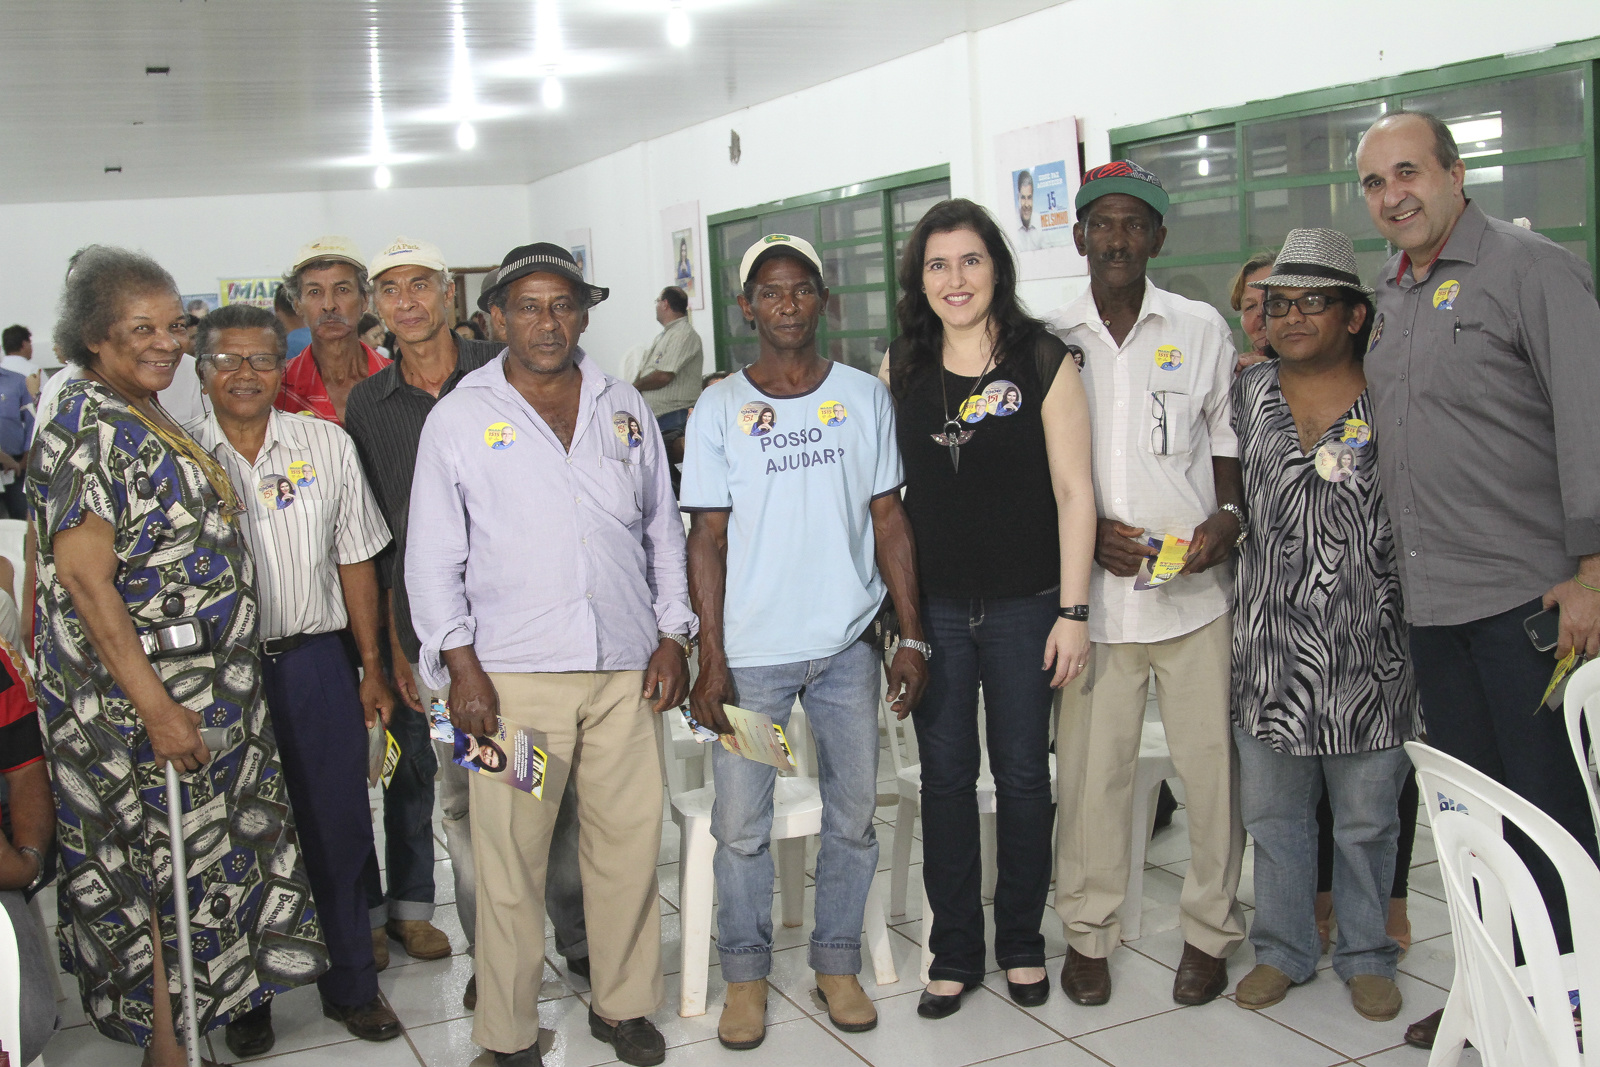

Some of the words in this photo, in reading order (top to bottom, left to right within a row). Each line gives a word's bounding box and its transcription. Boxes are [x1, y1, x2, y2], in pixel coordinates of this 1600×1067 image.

[1047, 191, 1057, 210] 15
[988, 394, 999, 404] 151
[760, 428, 823, 452] POSSO
[766, 448, 845, 475] AJUDAR?
